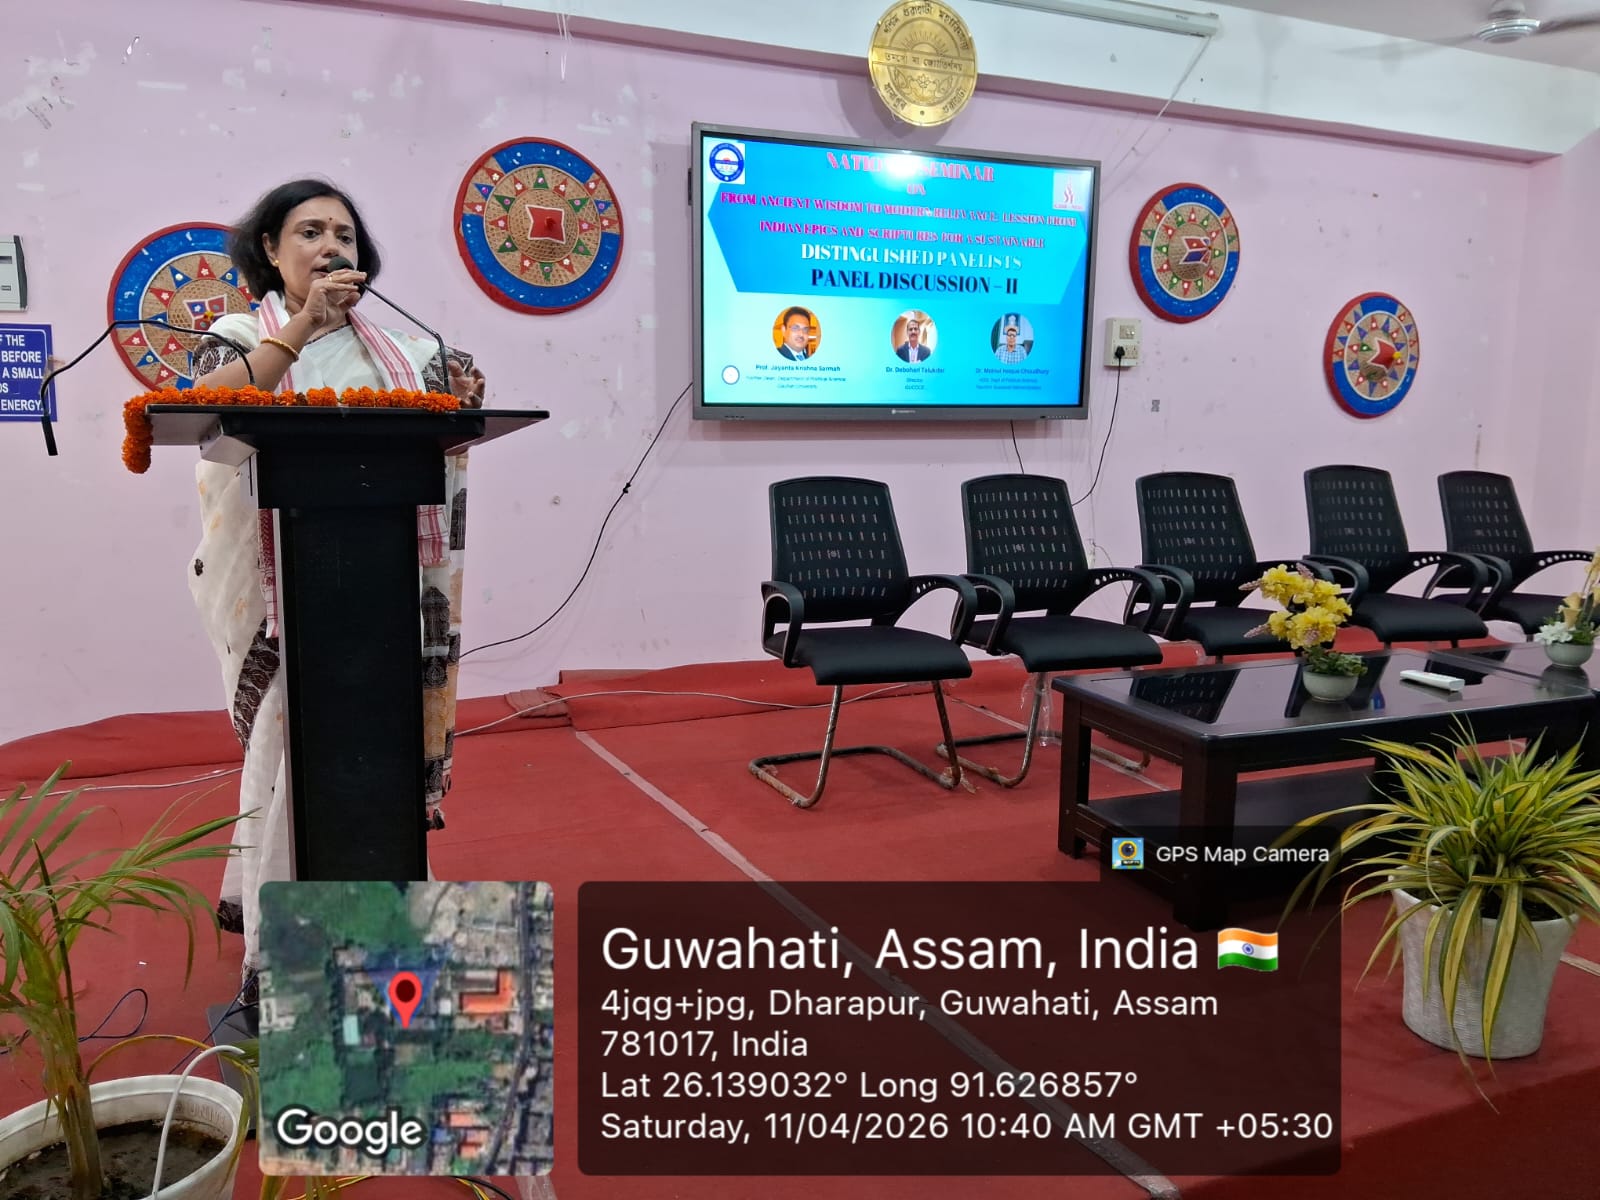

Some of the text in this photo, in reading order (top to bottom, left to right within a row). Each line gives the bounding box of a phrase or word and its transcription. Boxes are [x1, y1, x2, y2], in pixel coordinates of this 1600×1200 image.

[826, 151, 995, 182] NATIO SEMINAR
[719, 191, 757, 206] FROM
[760, 195, 811, 210] ANCIENT
[814, 199, 864, 214] WISDOM
[866, 203, 882, 215] TO
[884, 204, 931, 219] MODERN
[1046, 215, 1077, 228] FROM
[759, 220, 1045, 249] INDIAN EPICS AND SCRIPTURES FOR A SUSTAINABLE
[801, 243, 1022, 270] DISTINGUISHED PANELISTS
[810, 268, 874, 291] PANEL
[878, 271, 990, 295] DISCUSSION
[1005, 278, 1018, 295] II
[6, 334, 25, 346] THE
[1, 351, 42, 363] BEFORE
[2, 367, 43, 379] A SMALL
[1, 400, 44, 411] ENERGY.
